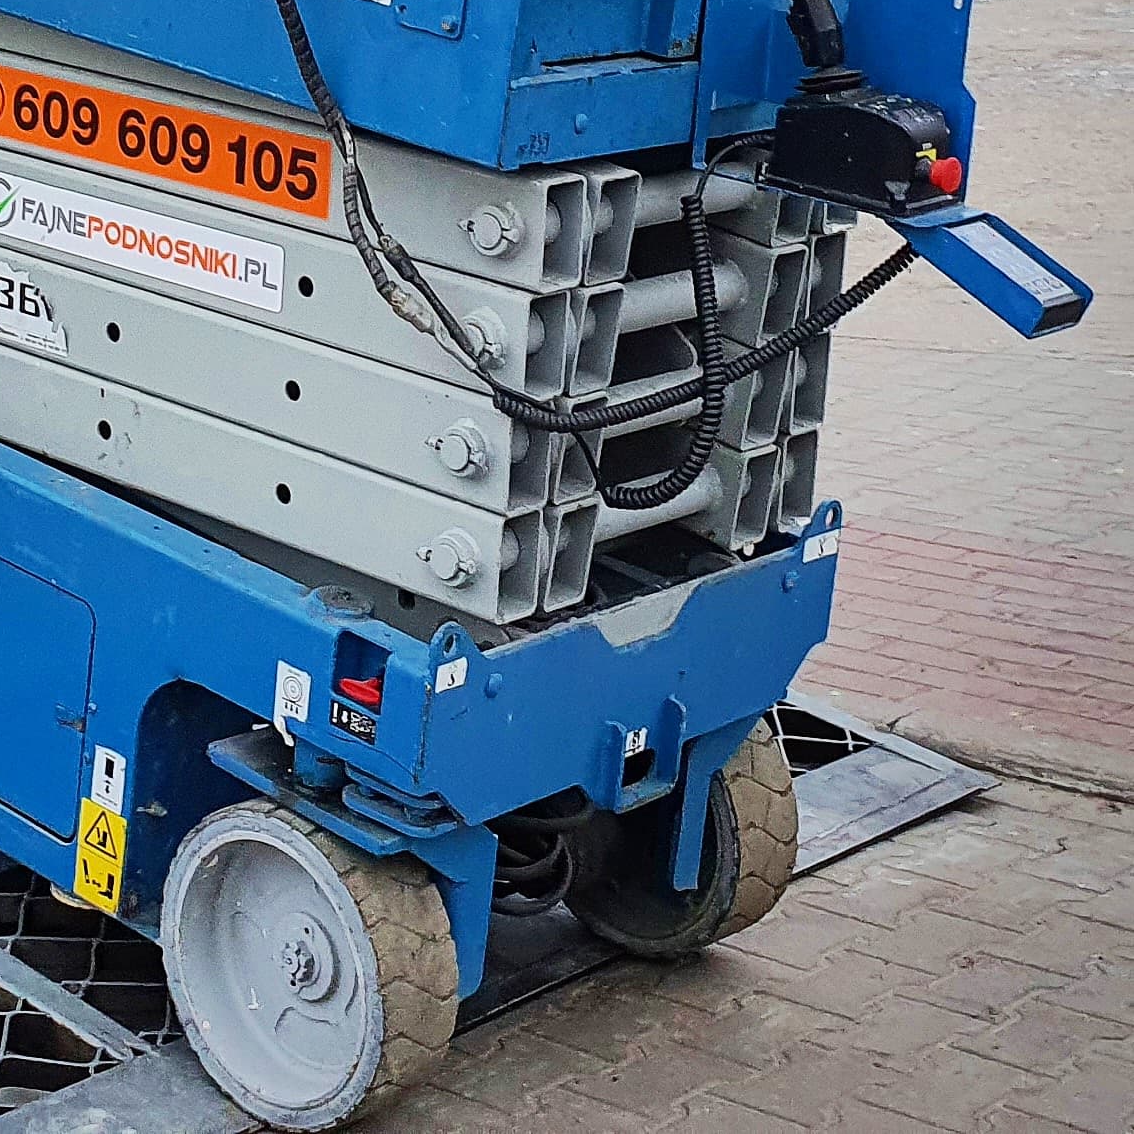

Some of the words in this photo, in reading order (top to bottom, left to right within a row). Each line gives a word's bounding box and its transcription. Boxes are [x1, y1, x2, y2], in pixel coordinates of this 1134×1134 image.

[13, 83, 100, 146] 609
[117, 108, 211, 174] 609
[227, 134, 318, 201] 105
[21, 197, 278, 290] FAJNEPODNOSNIKI.PL
